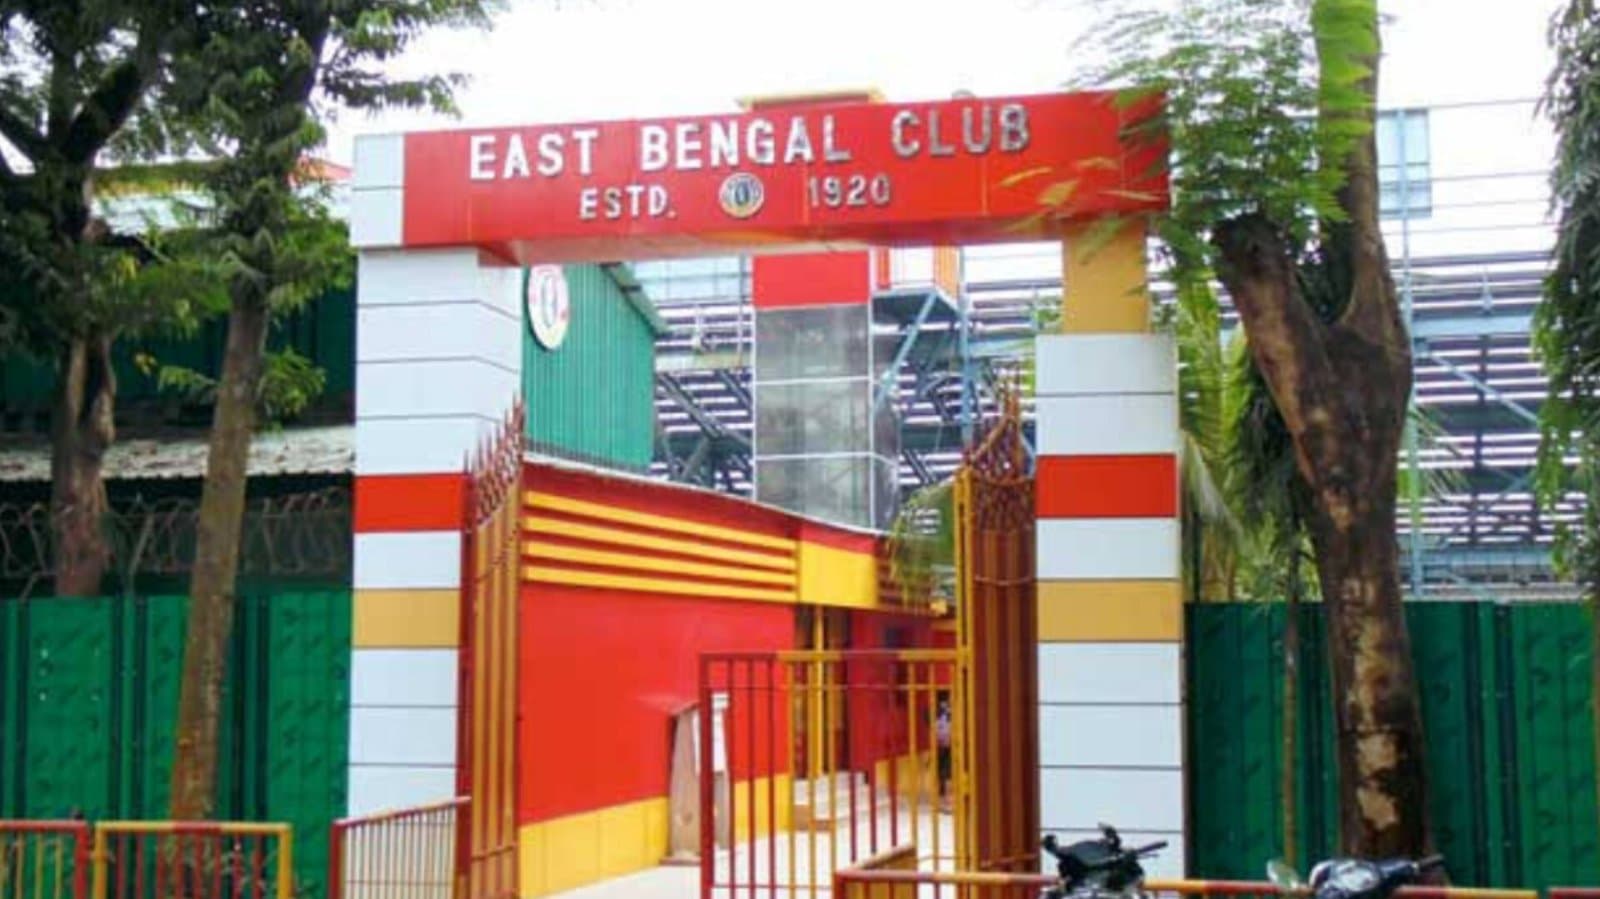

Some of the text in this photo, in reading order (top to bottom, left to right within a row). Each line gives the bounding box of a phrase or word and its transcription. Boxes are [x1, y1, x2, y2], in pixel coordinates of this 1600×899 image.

[470, 104, 1029, 179] EAST BENGAL CLUB
[581, 174, 891, 219] ESTD. 1920
